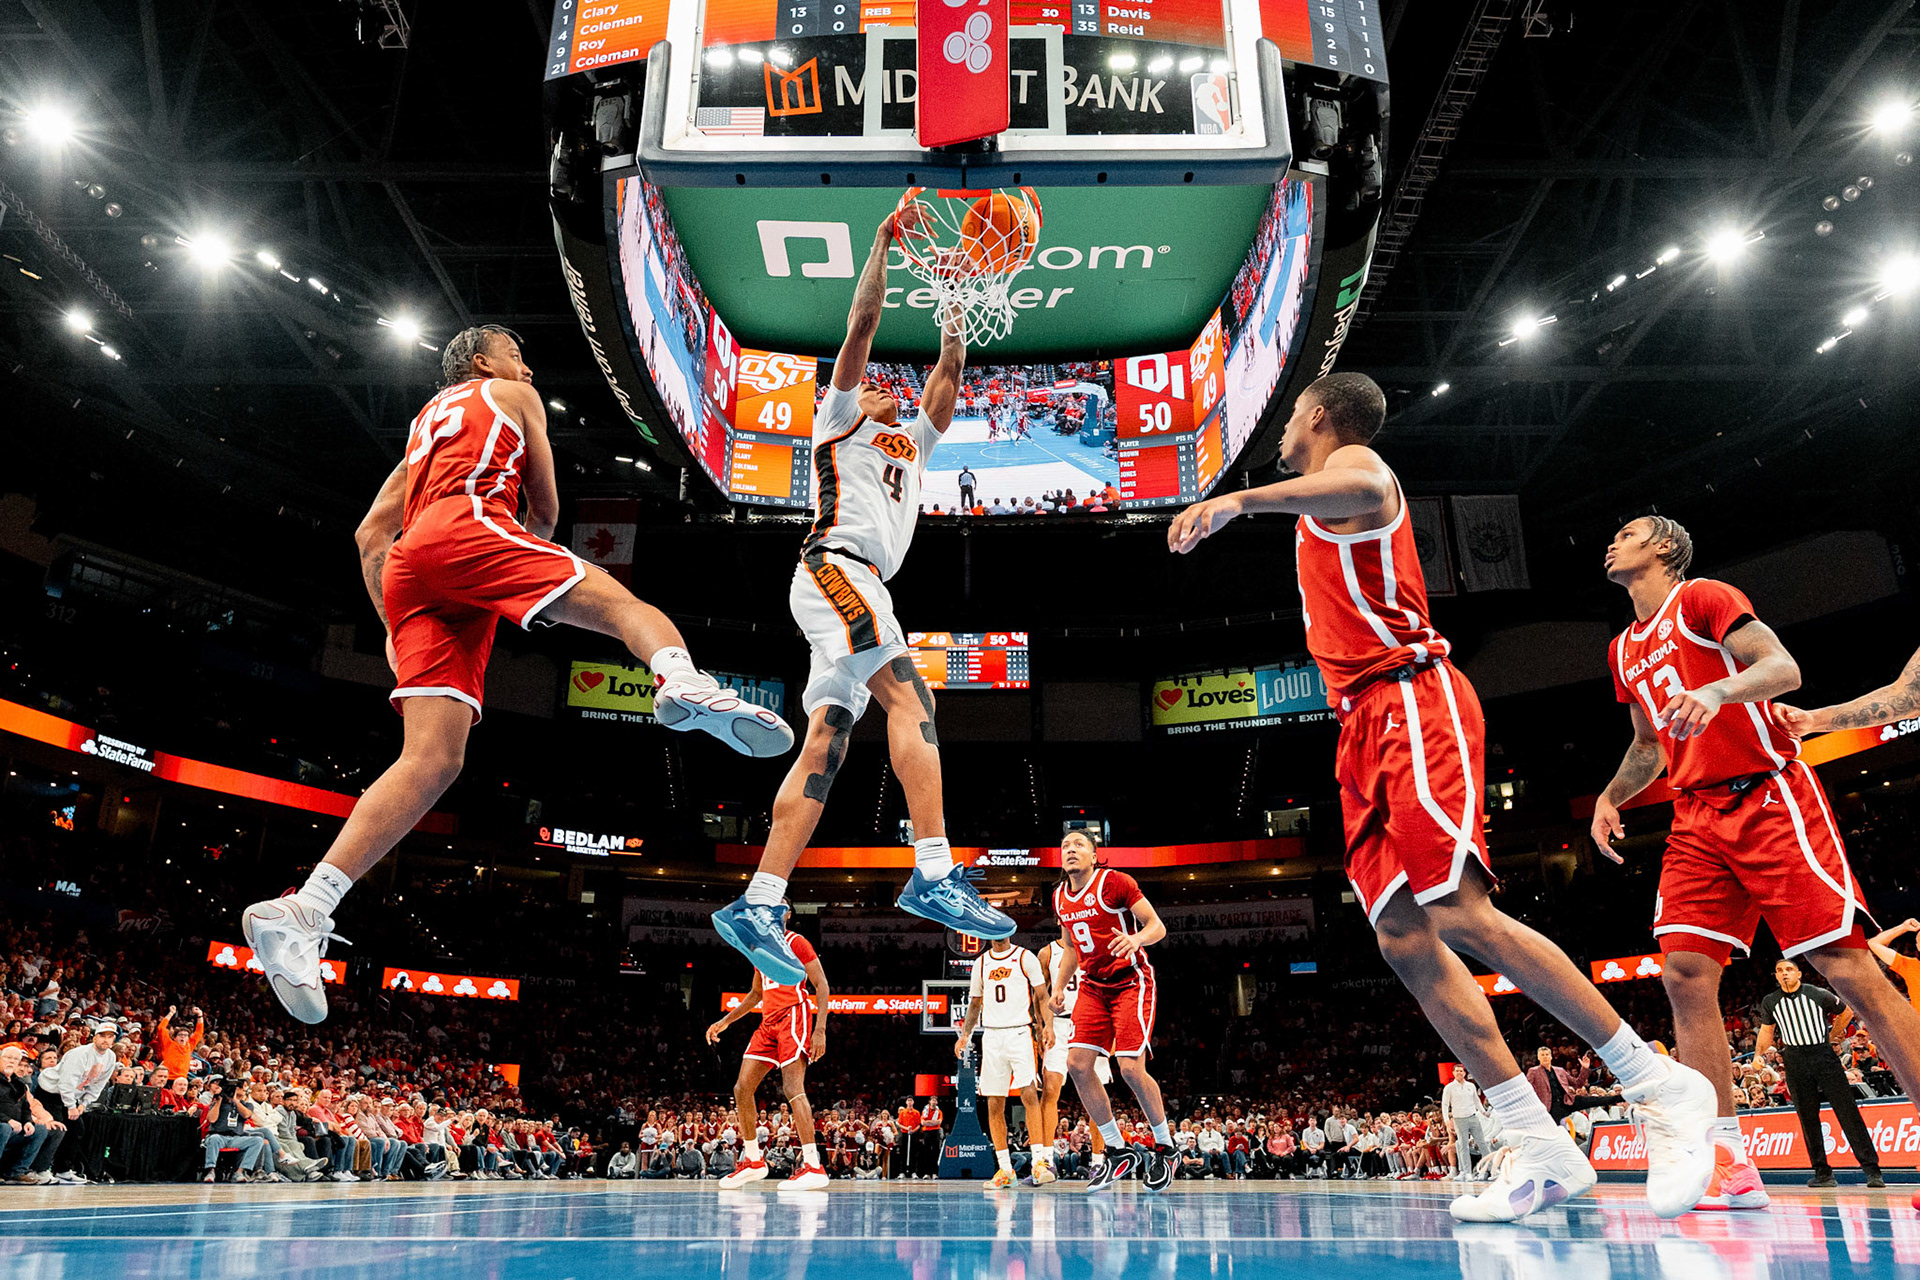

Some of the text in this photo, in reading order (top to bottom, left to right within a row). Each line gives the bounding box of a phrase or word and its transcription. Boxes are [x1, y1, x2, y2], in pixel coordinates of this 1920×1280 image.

[562, 4, 619, 24] 1 Clary
[790, 4, 892, 18] 13 0 REB
[1042, 4, 1152, 20] 30 13 Davis
[1320, 6, 1366, 26] 15 1
[558, 14, 643, 40] 4 Coleman
[791, 20, 845, 34] 0 0
[1077, 21, 1098, 32] 35
[1108, 23, 1144, 36] Reid
[1324, 22, 1369, 42] 9 1
[556, 38, 606, 58] 9 Roy
[1326, 38, 1371, 58] 2 1
[551, 48, 640, 75] 21 Coleman
[1328, 55, 1374, 74] 5 0
[1200, 124, 1218, 134] NBA
[713, 369, 728, 412] 50
[1202, 372, 1217, 410] 49
[758, 400, 792, 432] 49
[1139, 402, 1172, 433] 50
[408, 388, 474, 466] 35
[882, 463, 904, 503] 4
[816, 563, 866, 622] COWBOYS
[928, 635, 946, 645] 49
[990, 635, 1008, 645] 50
[1624, 639, 1679, 682] OKLAHOMA
[1262, 672, 1311, 710] LOUD
[1636, 664, 1686, 732] 13
[582, 710, 618, 720] BRING
[621, 713, 643, 723] THE
[1168, 724, 1201, 735] BRING
[1204, 722, 1226, 732] THE
[1228, 717, 1282, 729] THUNDER
[1299, 713, 1326, 723] EXIT
[98, 734, 136, 753] PRESENTED
[552, 828, 625, 850] BEDLAM
[566, 844, 609, 856] BASKETBALL
[1059, 908, 1099, 922] OKLAHOMA
[1220, 912, 1254, 925] PARTY
[1072, 921, 1096, 954] 9
[995, 984, 1006, 1003] 0
